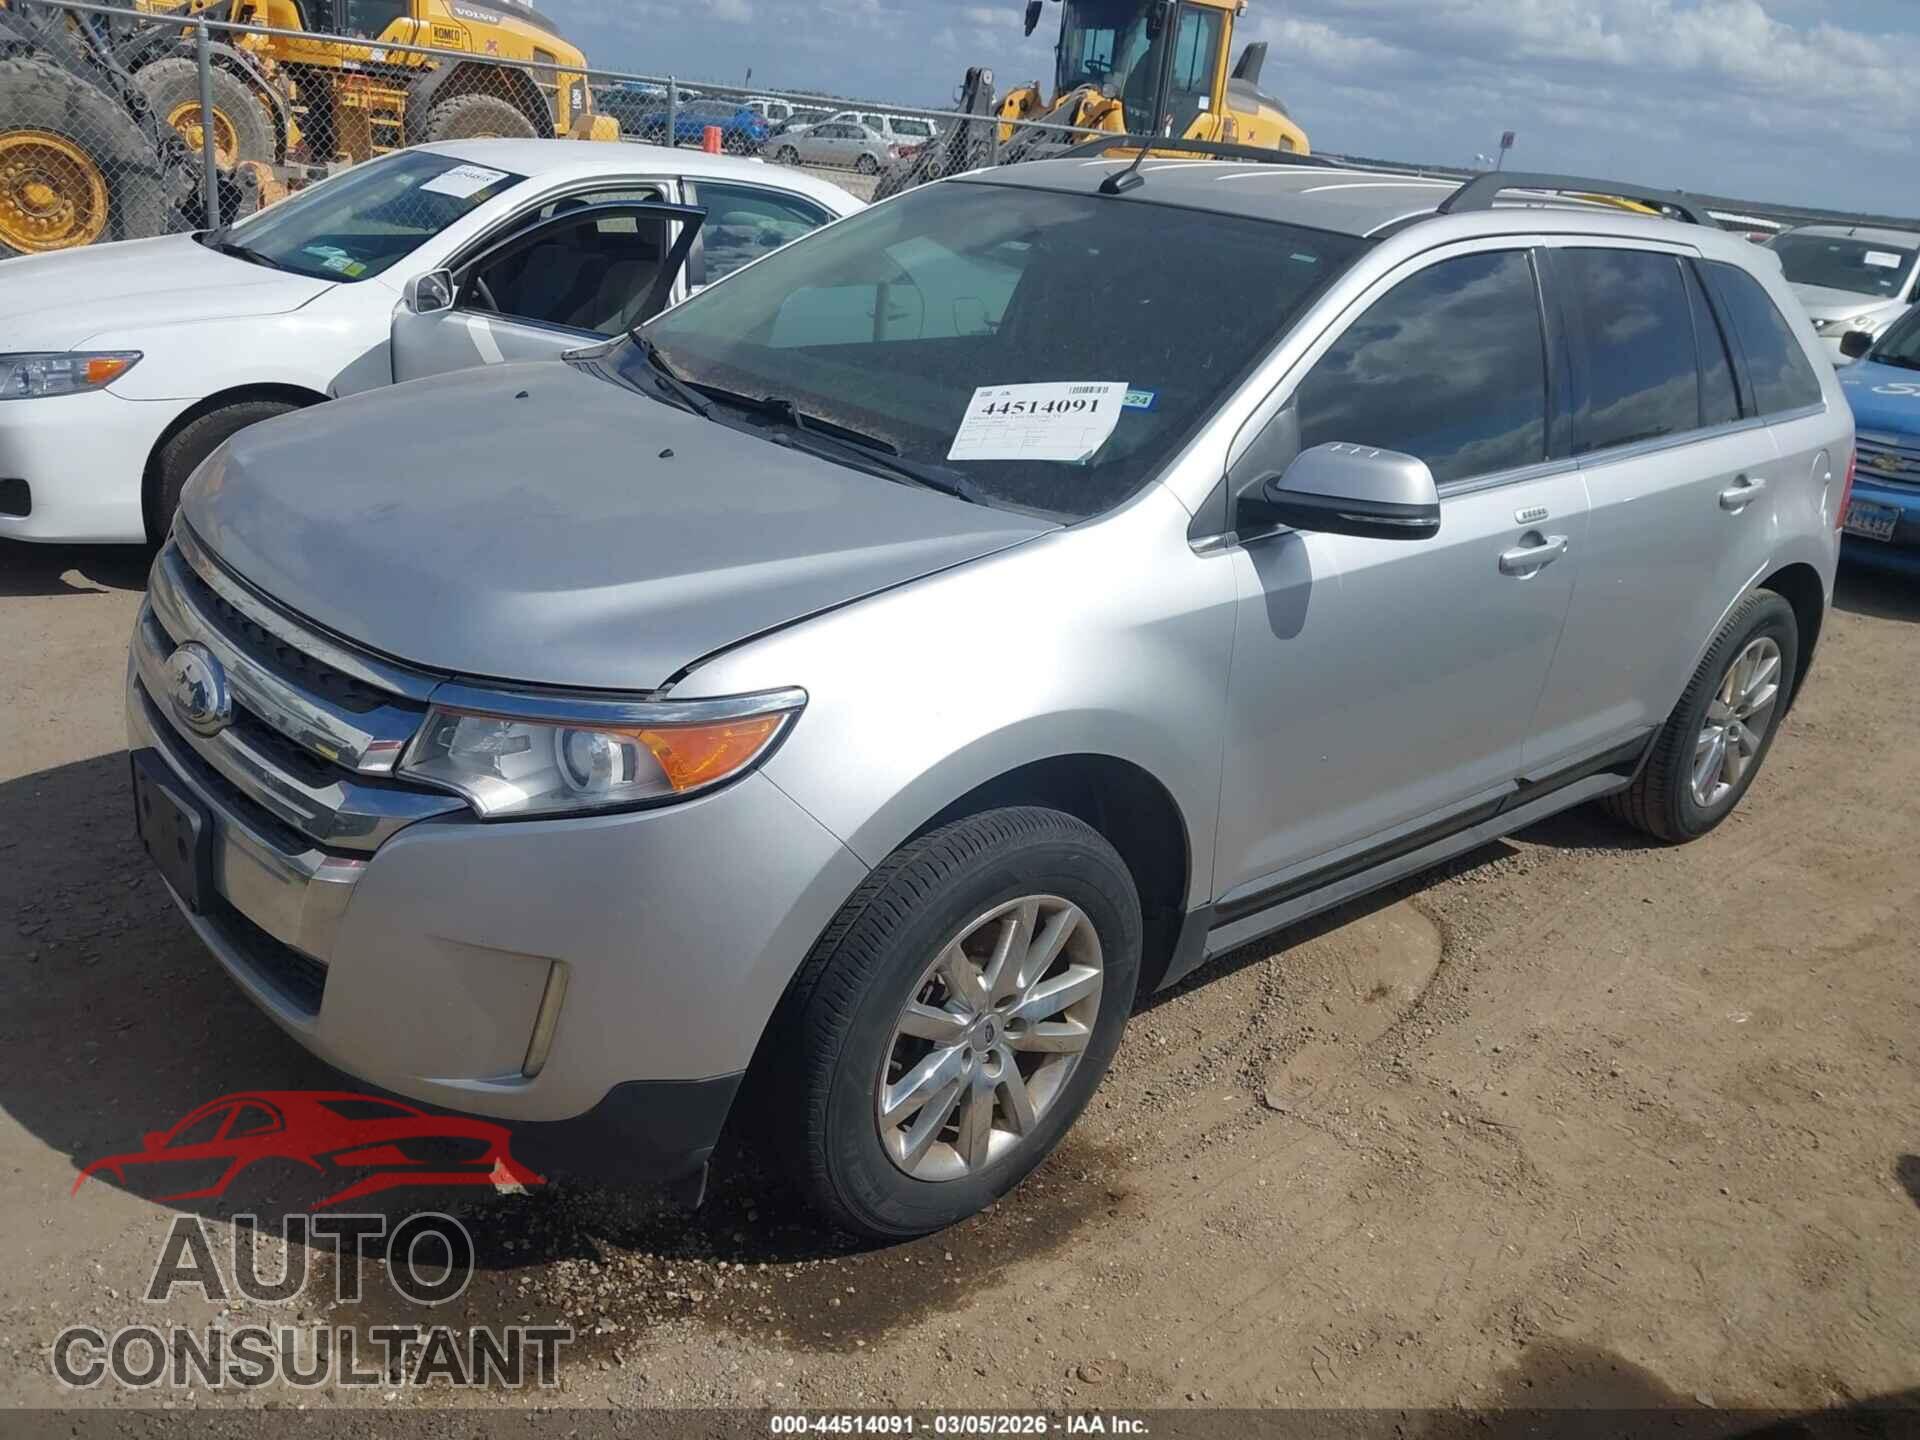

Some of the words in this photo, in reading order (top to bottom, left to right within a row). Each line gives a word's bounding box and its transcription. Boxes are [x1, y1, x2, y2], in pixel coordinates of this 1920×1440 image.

[455, 7, 499, 23] VOLVO
[433, 26, 460, 41] ROMCO
[981, 399, 1099, 415] 44514091
